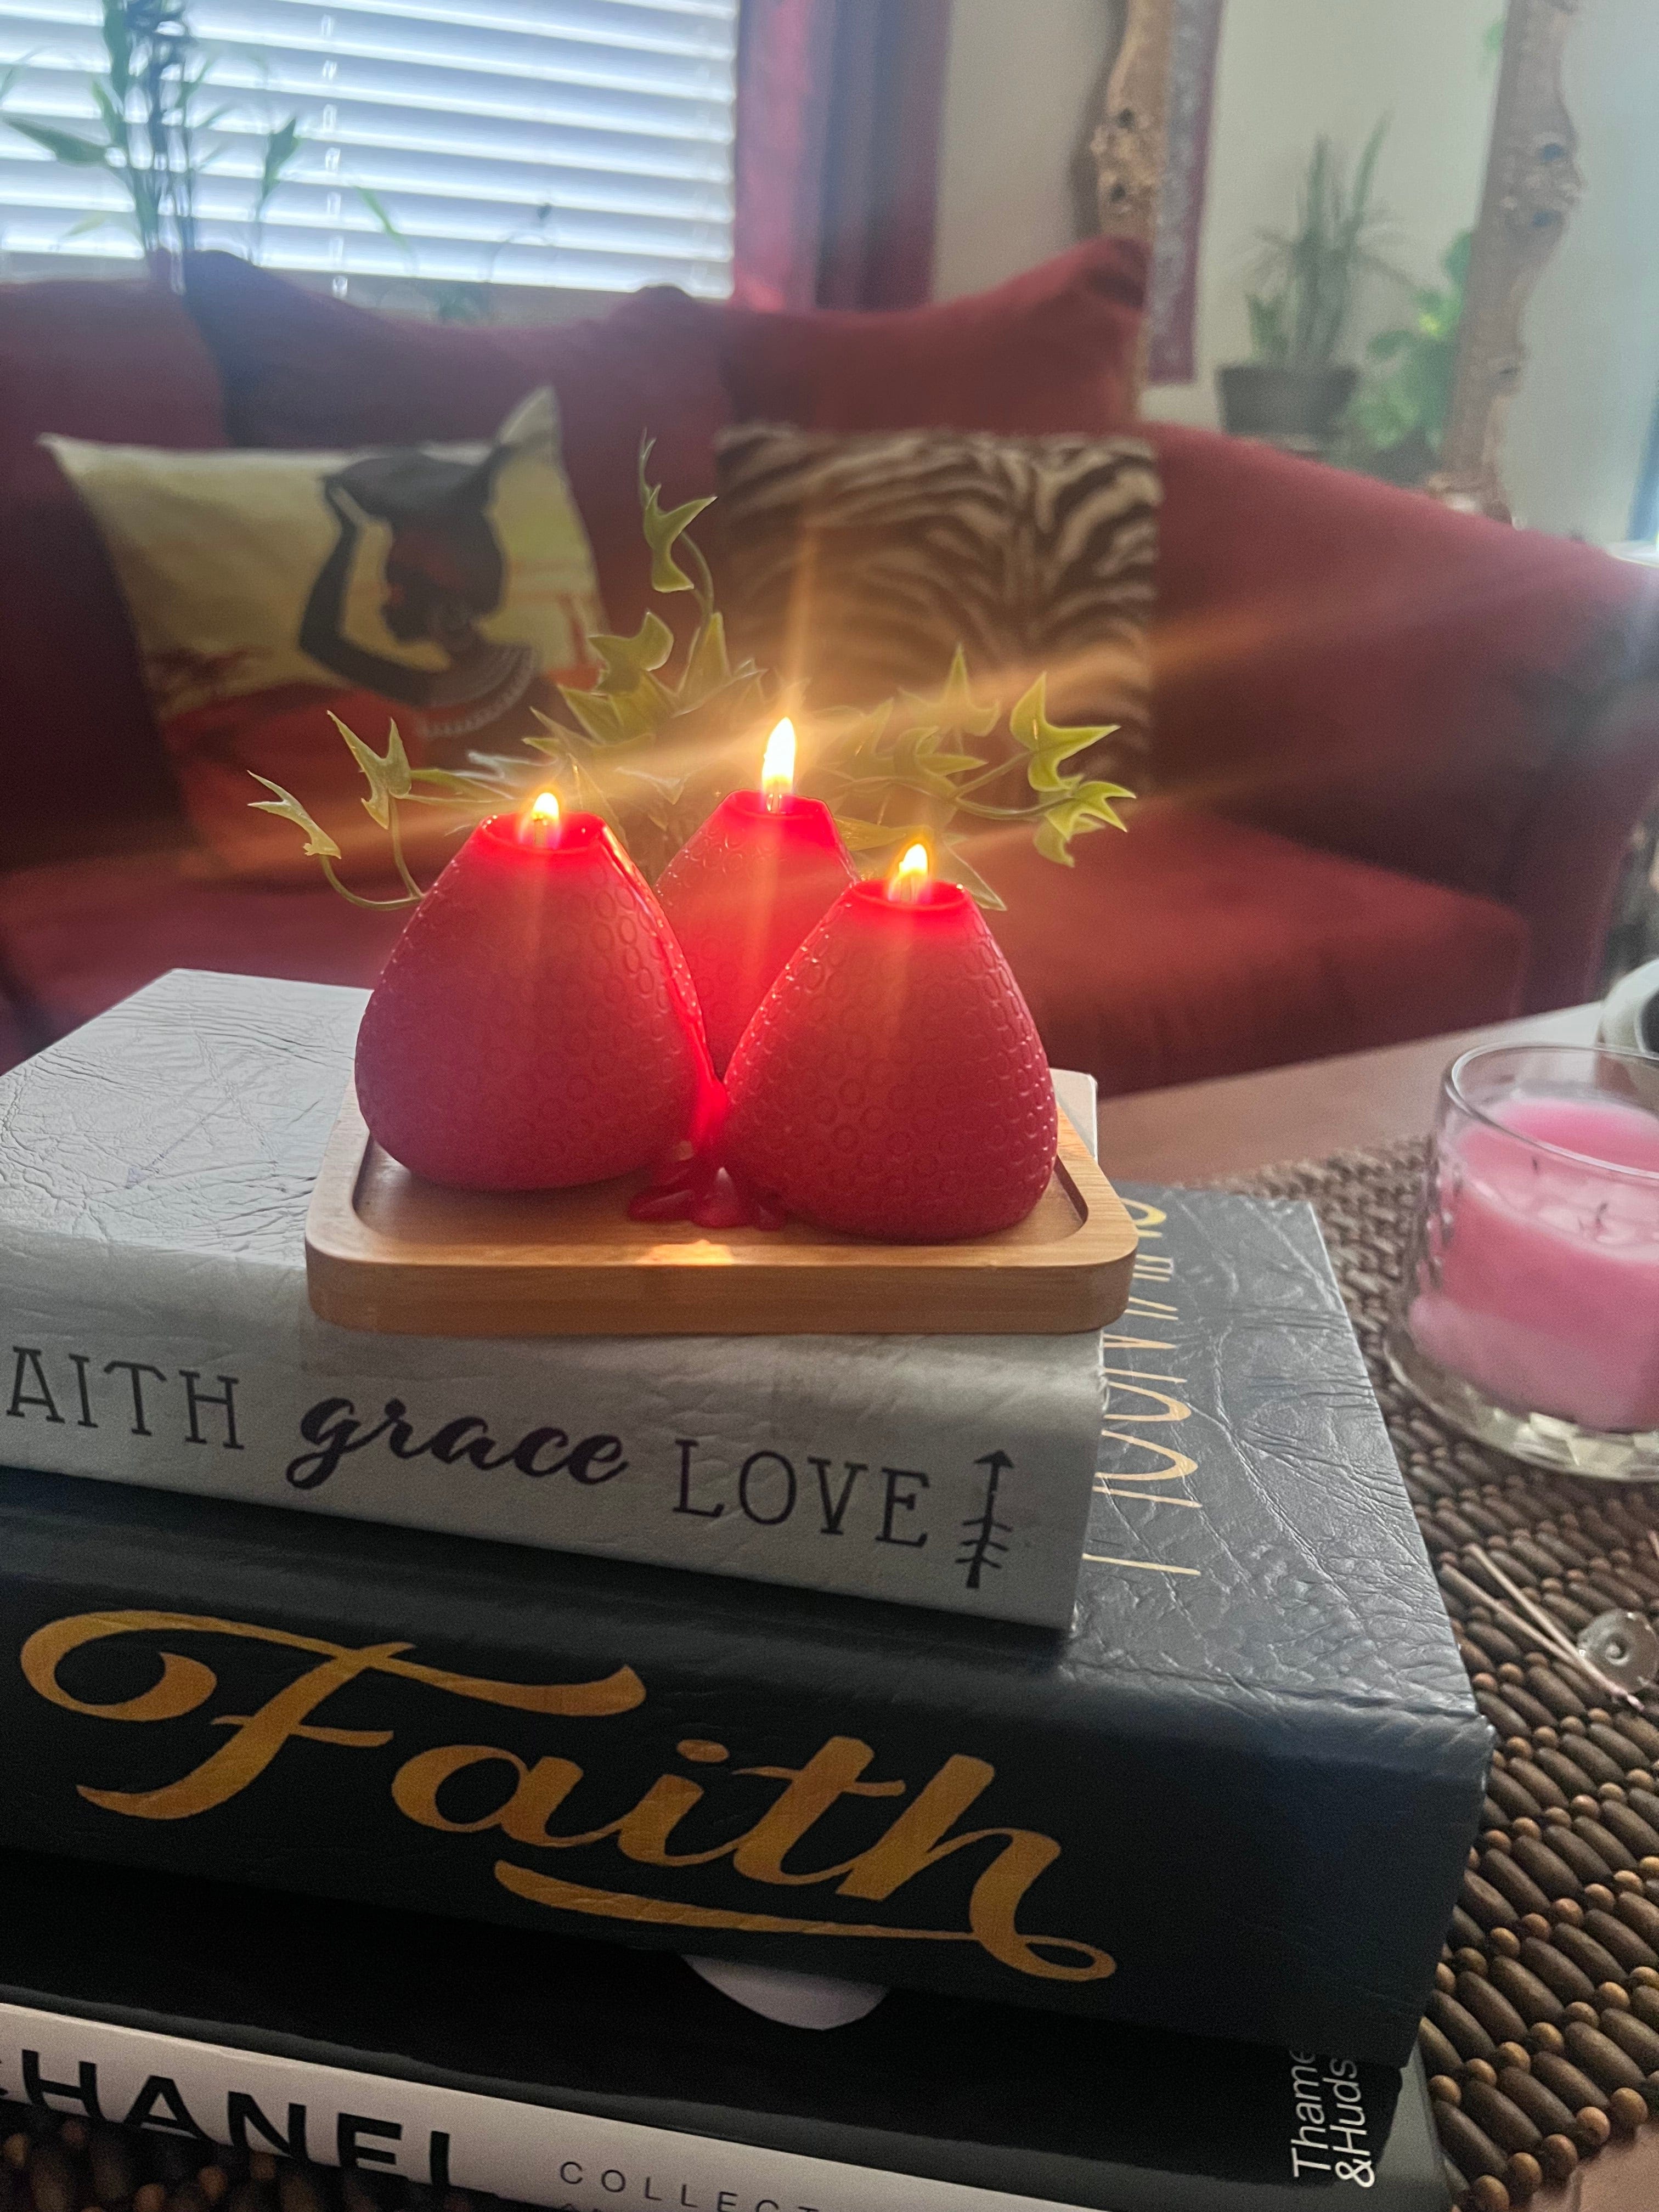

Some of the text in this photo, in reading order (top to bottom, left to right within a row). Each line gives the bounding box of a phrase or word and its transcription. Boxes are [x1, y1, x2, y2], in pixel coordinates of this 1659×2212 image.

[6, 1346, 930, 1548] AITH grace LOVE
[21, 1609, 1117, 1981] Faith
[0, 2050, 450, 2190] HANEL
[560, 2161, 819, 2212] COLLEC
